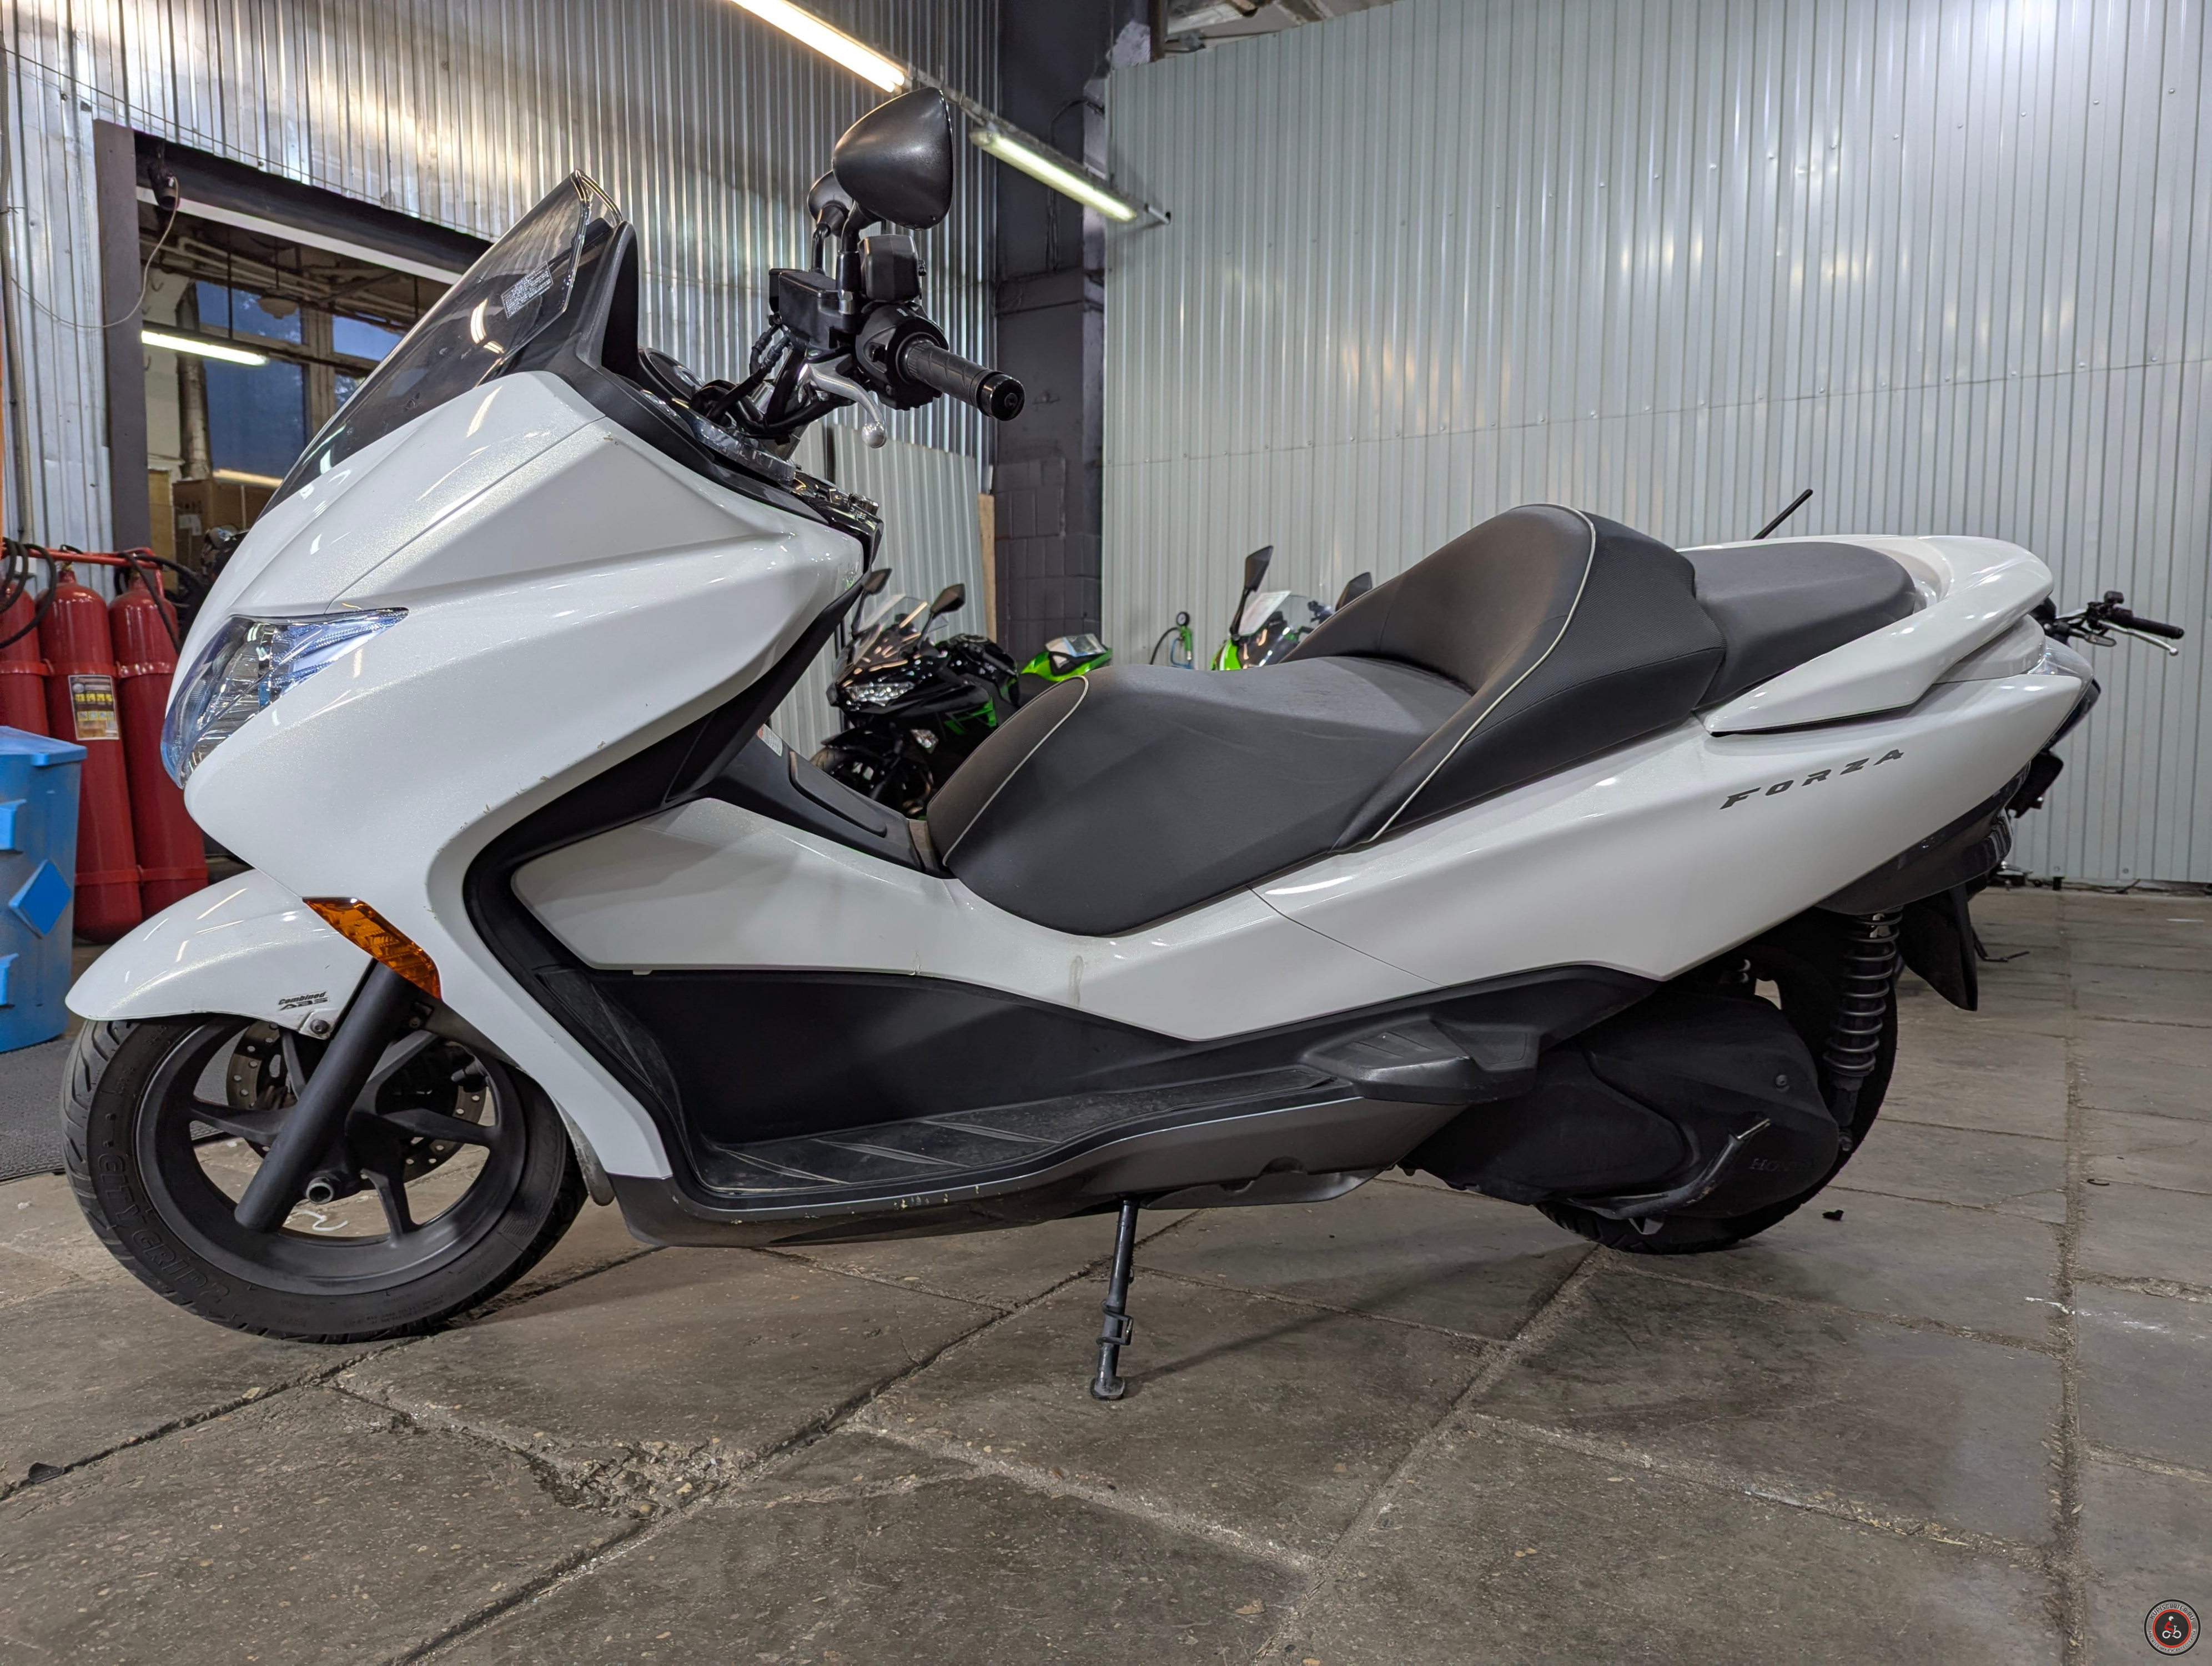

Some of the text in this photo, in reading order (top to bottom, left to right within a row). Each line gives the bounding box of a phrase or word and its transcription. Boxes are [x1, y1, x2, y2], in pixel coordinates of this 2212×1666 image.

[1719, 749, 1905, 810] FORZA
[278, 991, 326, 1005] Combined
[279, 997, 329, 1011] ABS
[132, 1229, 208, 1288] GRIP
